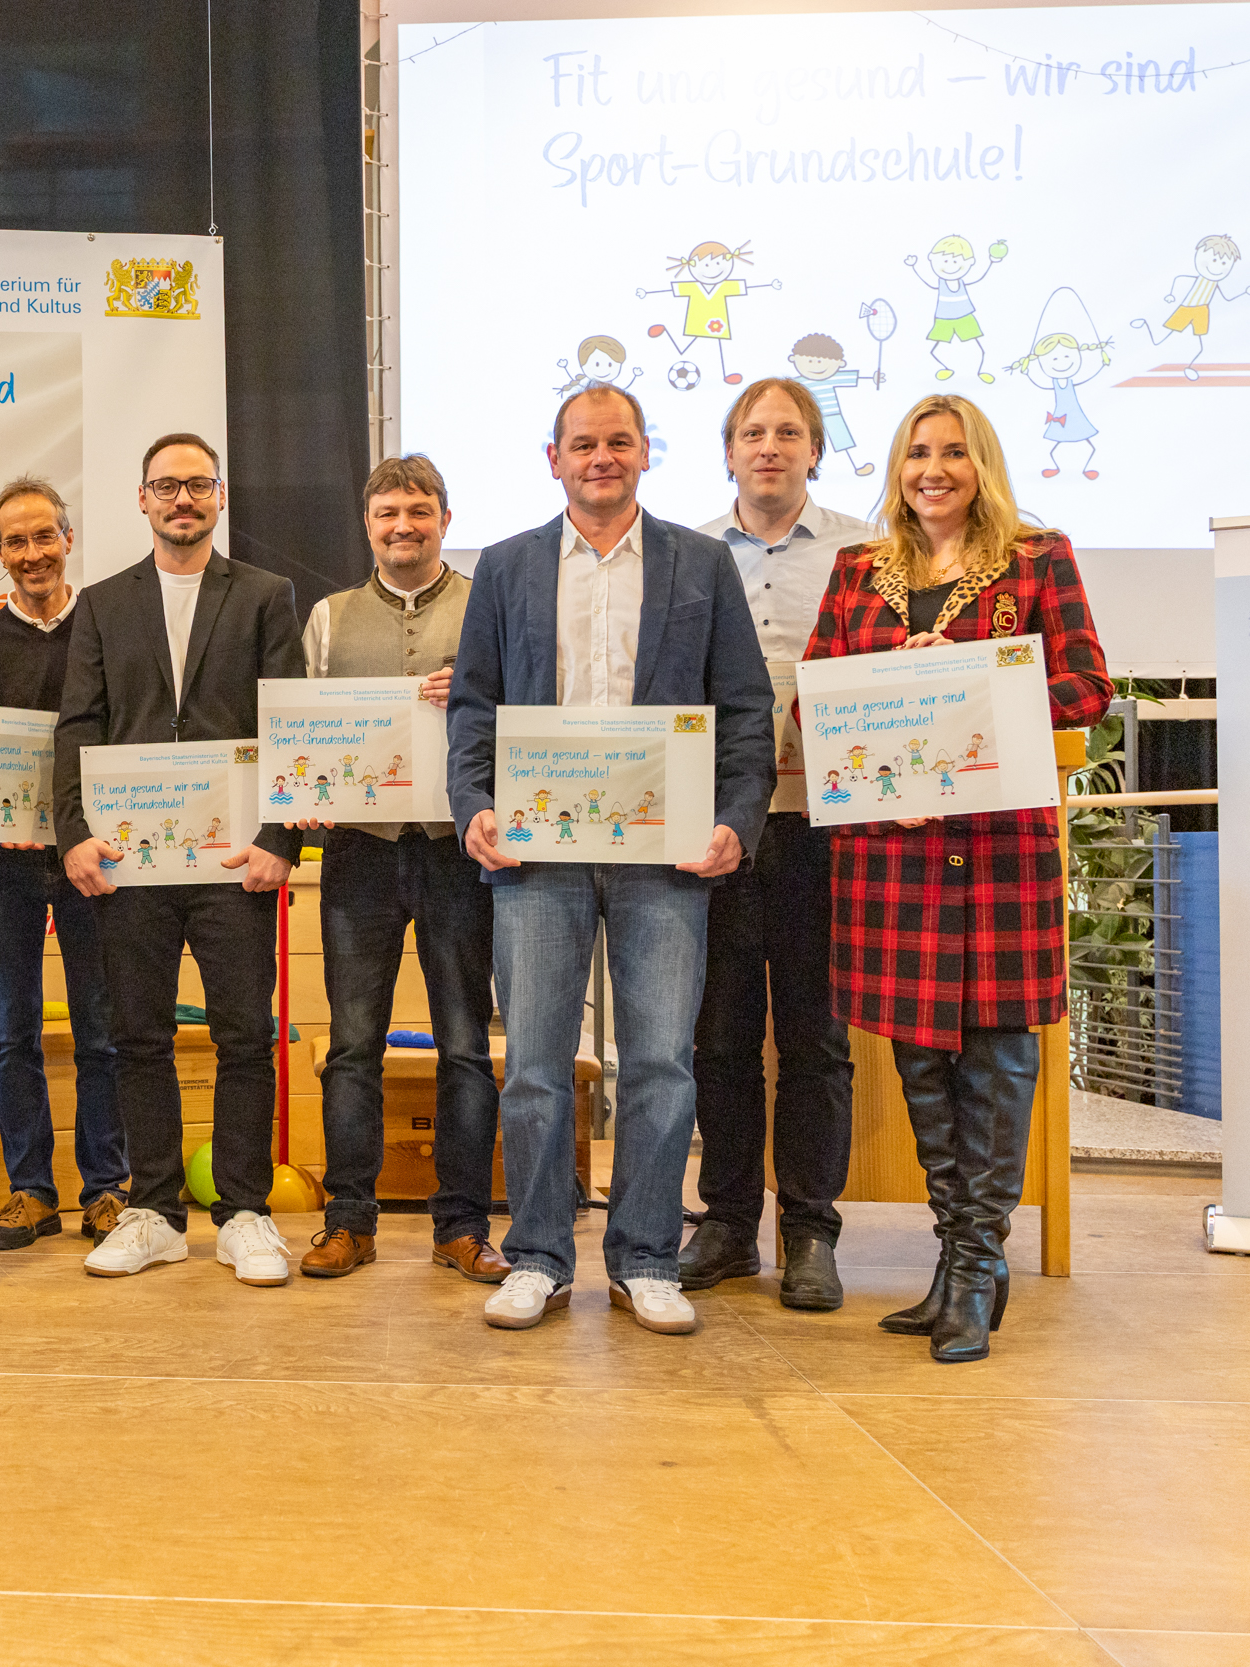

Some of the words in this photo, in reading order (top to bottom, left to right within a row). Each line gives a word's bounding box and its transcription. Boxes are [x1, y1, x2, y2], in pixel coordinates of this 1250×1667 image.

[543, 50, 612, 106] Fit
[637, 57, 726, 104] und
[753, 53, 926, 126] gesund
[1005, 54, 1081, 98] wir
[1101, 47, 1196, 94] sind
[543, 124, 1024, 207] Sport-Grundschule!
[57, 276, 81, 293] für
[27, 298, 81, 314] Kultus
[872, 664, 912, 674] Bayerisches
[914, 658, 975, 669] Staatsministerium
[916, 667, 949, 676] Unterricht
[952, 664, 964, 672] und
[966, 663, 988, 671] Kultus
[772, 703, 783, 713] nd
[814, 703, 829, 718] Fit
[836, 702, 857, 716] und
[863, 697, 904, 718] gesund
[919, 694, 938, 706] wir
[942, 690, 966, 704] sind
[270, 717, 282, 728] Fit
[287, 718, 304, 728] und
[309, 718, 342, 732] gesund
[355, 718, 370, 727] wir
[373, 717, 391, 727] sind
[815, 712, 934, 740] Sport-Grundschule!
[269, 733, 365, 749] Sport-Grundschule!
[45, 750, 55, 758] sin
[509, 747, 523, 760] Fit
[528, 749, 547, 760] und
[553, 749, 589, 765] gesund
[605, 750, 621, 760] wir
[625, 750, 645, 760] sind
[508, 765, 609, 781] Sport-Grundschule!
[93, 783, 105, 795] Fit
[110, 784, 126, 794] und
[131, 783, 162, 798] gesund
[174, 782, 189, 791] wir
[192, 781, 209, 791] sind
[93, 797, 184, 815] Sport-Grundschule!
